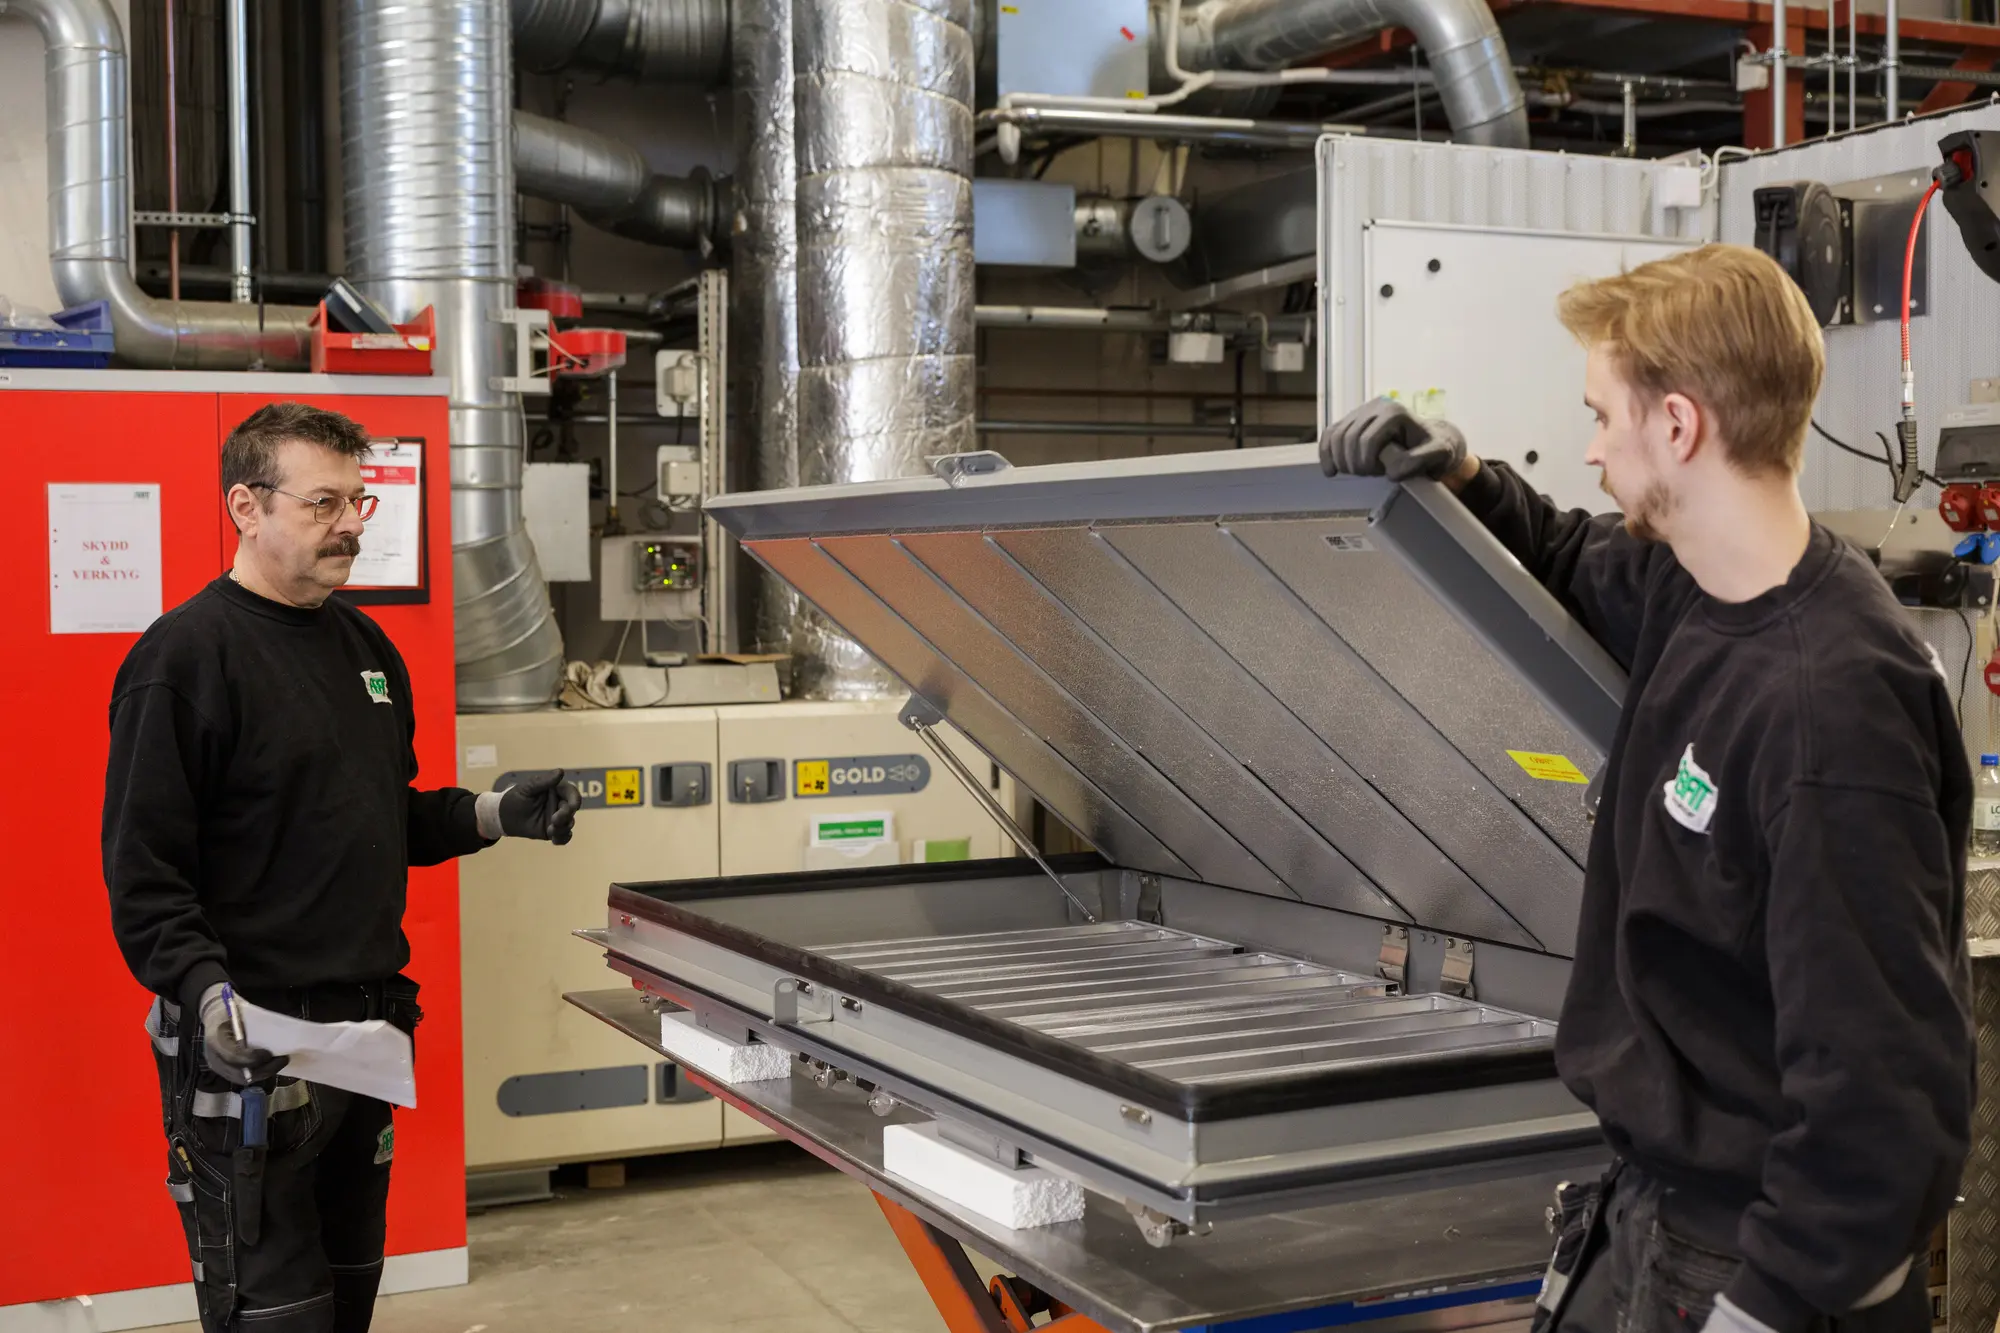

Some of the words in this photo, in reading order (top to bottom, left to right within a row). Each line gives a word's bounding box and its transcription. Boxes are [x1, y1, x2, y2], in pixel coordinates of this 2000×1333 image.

[82, 541, 129, 551] SKYDD
[100, 556, 110, 565] &
[72, 570, 140, 580] VERKTYG
[831, 766, 885, 785] GOLD
